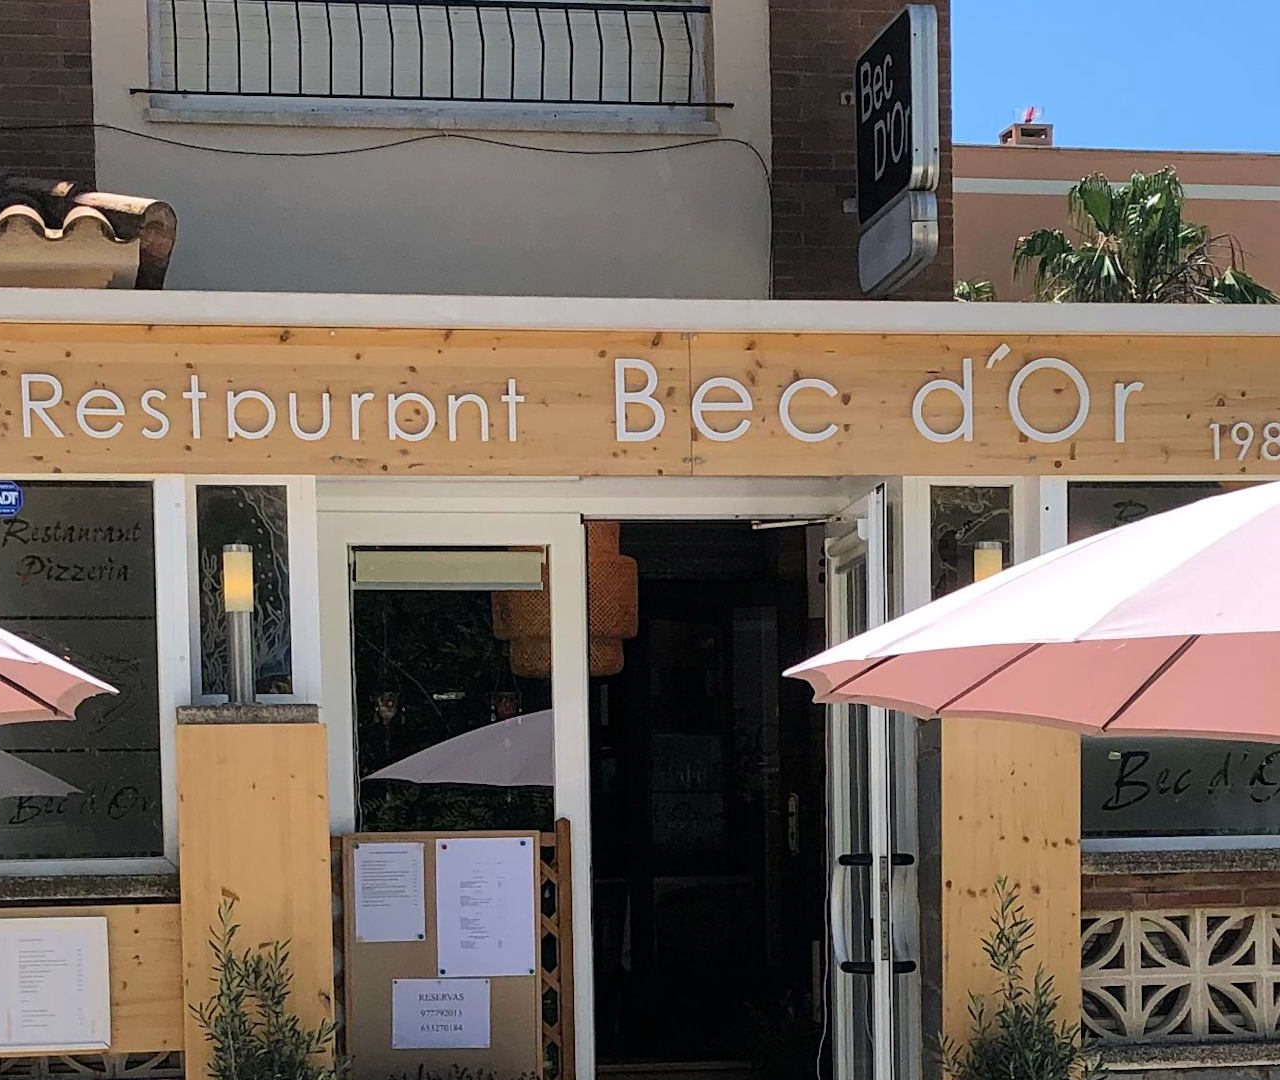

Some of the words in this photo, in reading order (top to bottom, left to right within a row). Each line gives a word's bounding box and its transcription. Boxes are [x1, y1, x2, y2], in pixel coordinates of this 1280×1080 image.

[861, 54, 894, 123] Bec
[874, 101, 911, 182] D'Or
[614, 358, 840, 442] Bec
[1, 517, 141, 547] Restaurant
[16, 554, 129, 587] Pizzeria
[1102, 750, 1191, 810] Bec
[8, 795, 69, 826] Bec
[418, 993, 465, 1001] RESERVAS
